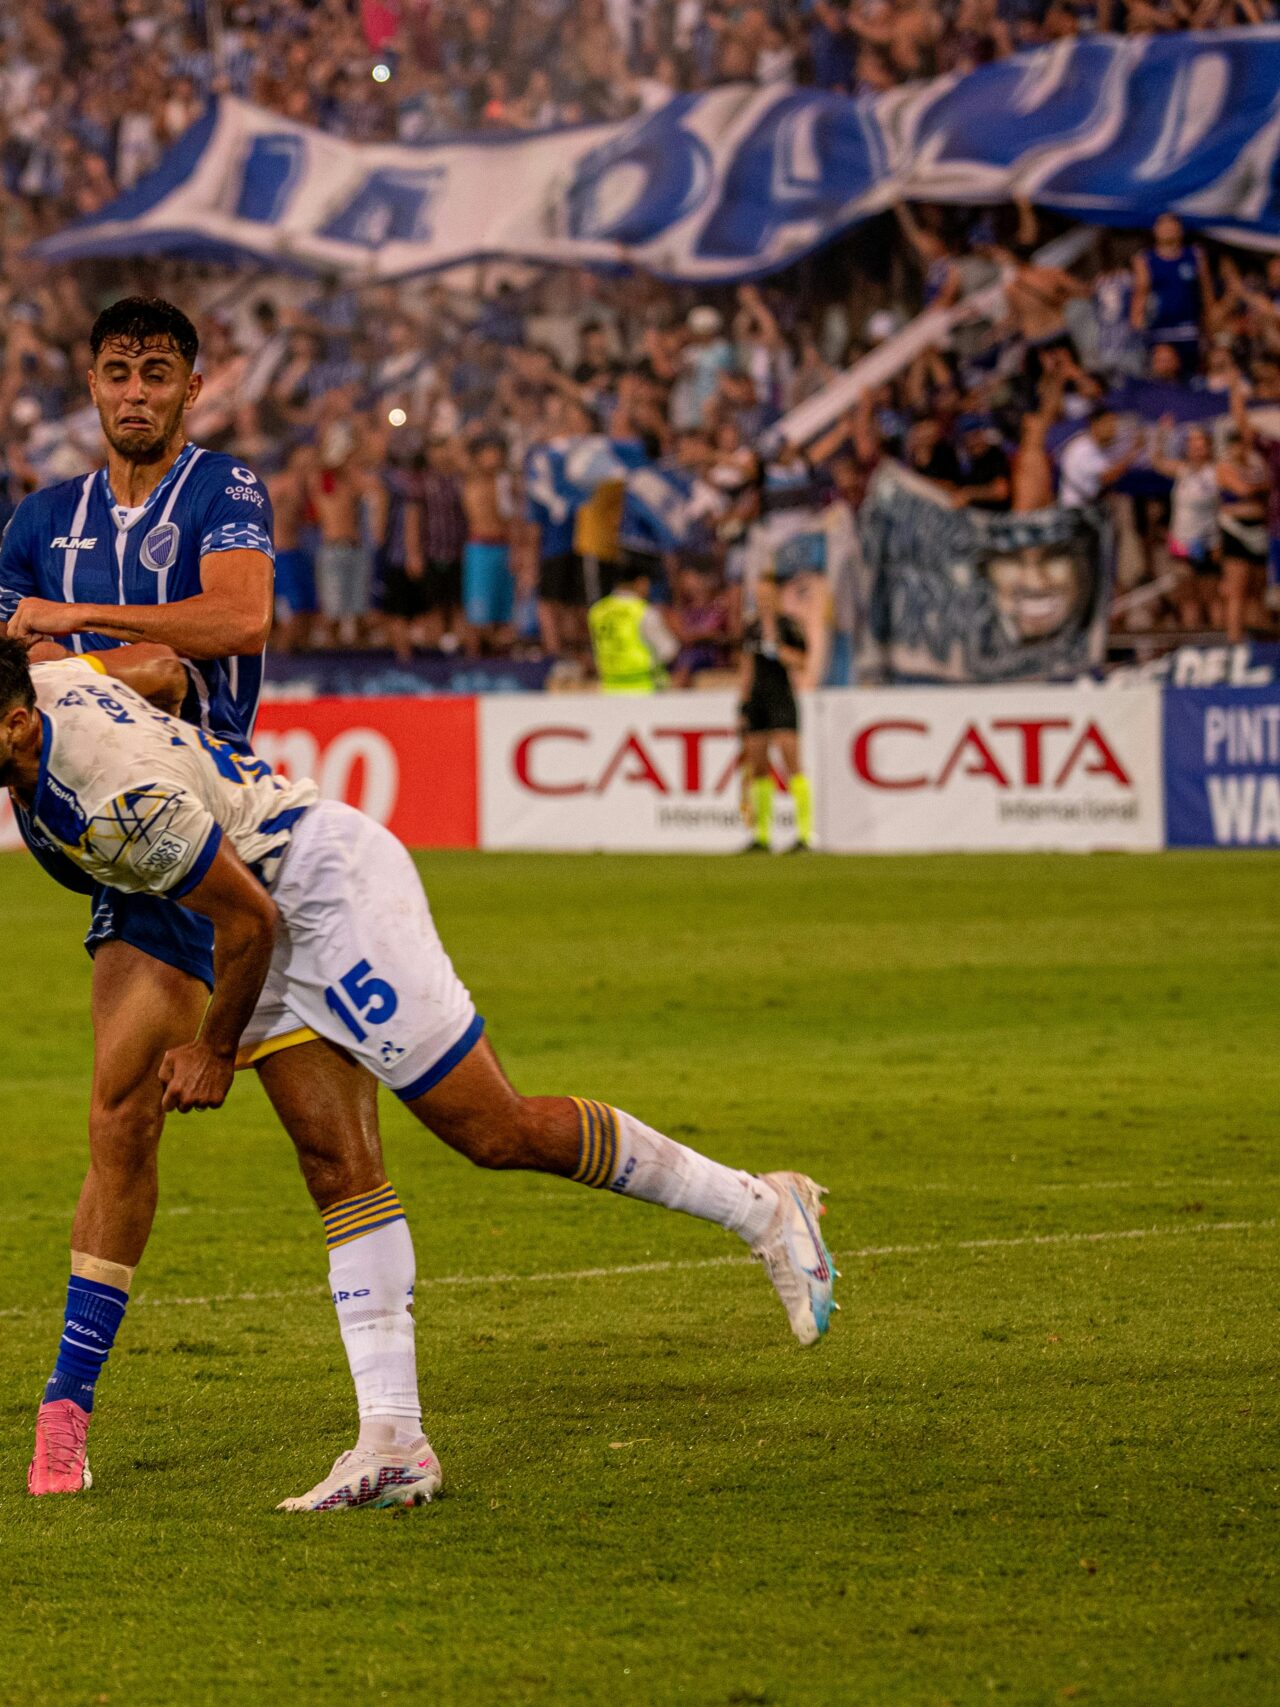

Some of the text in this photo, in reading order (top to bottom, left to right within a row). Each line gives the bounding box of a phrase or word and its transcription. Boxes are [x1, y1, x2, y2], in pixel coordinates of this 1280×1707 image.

[224, 485, 265, 502] GODOY
[231, 493, 263, 508] CRUZ
[49, 537, 97, 549] FIUME
[850, 717, 1133, 791] CATA
[324, 958, 398, 1044] 15
